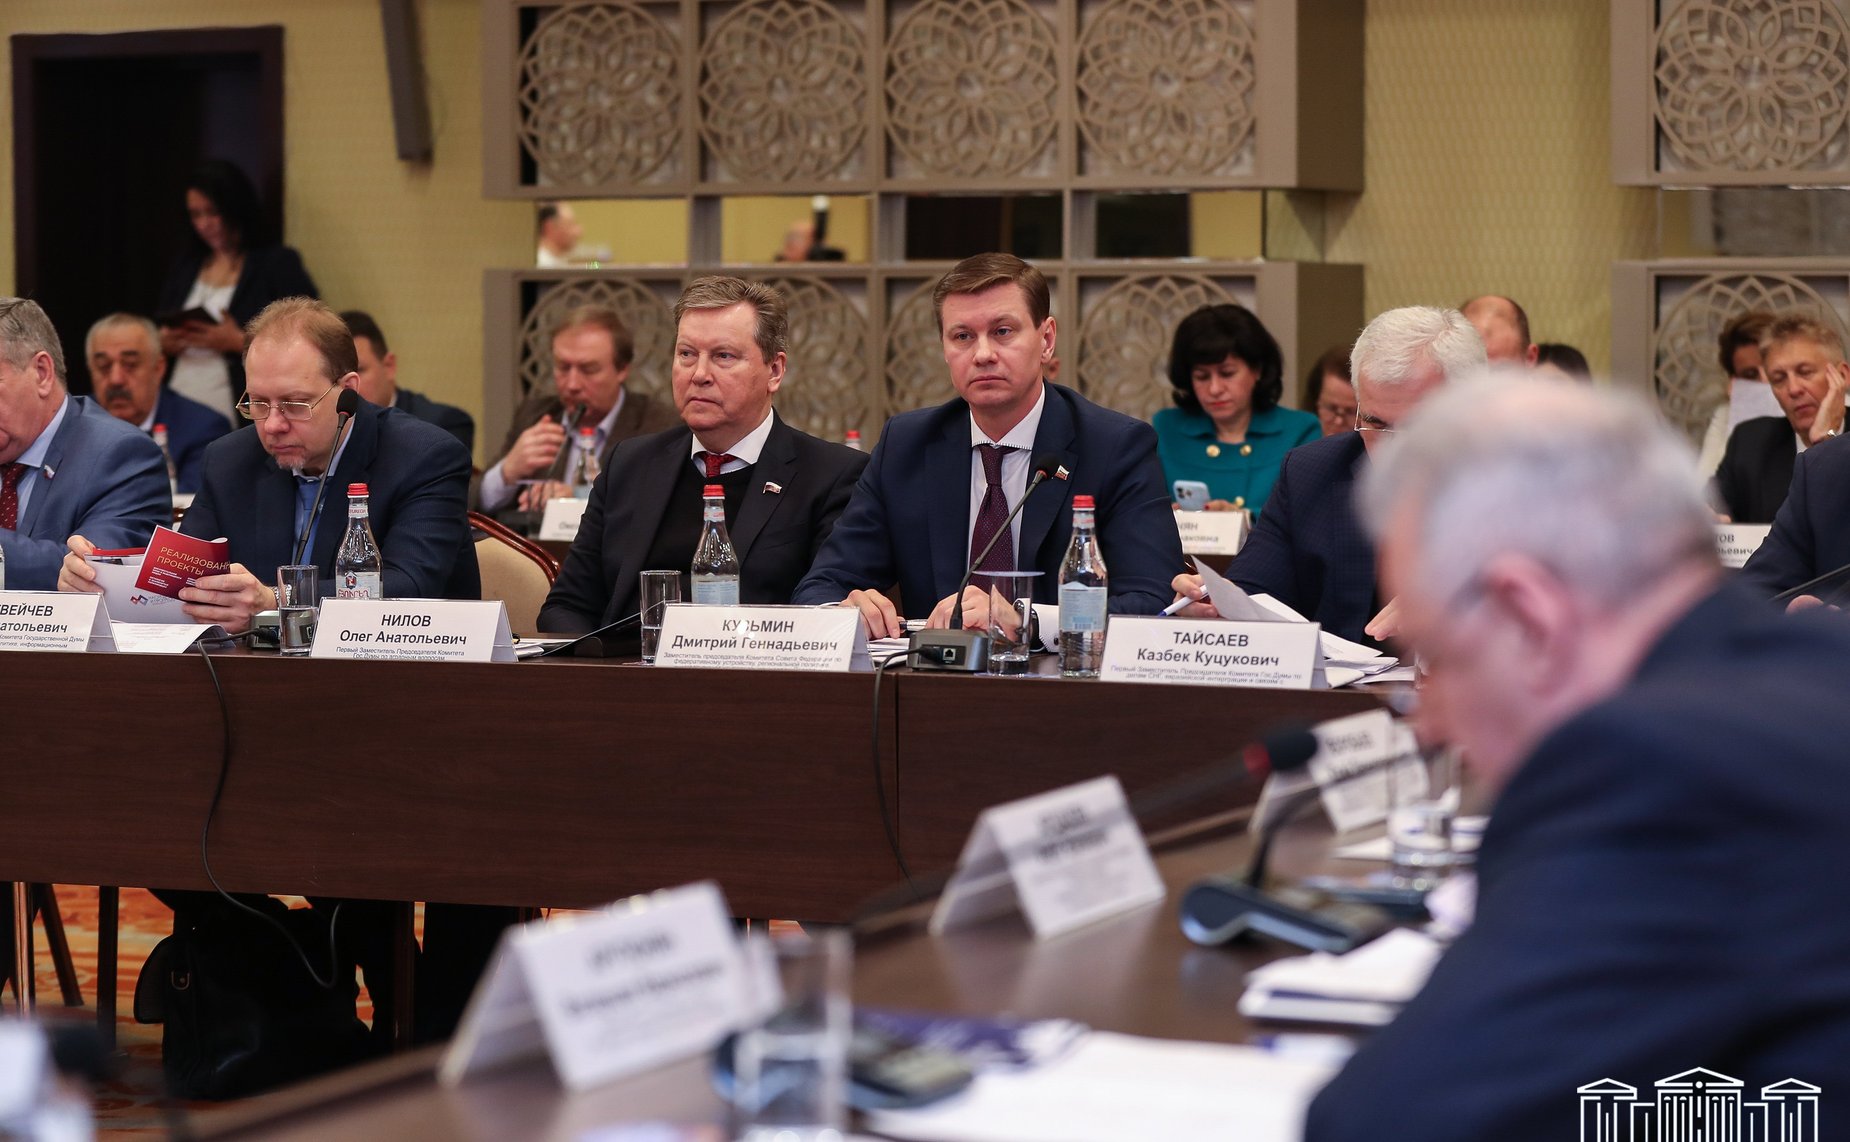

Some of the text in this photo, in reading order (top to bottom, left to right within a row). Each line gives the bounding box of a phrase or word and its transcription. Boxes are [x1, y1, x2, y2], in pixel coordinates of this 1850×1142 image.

[156, 555, 205, 577] ПРОЕКТЫ
[0, 603, 54, 617] ВЕЙЧЕВ
[0, 622, 68, 633] атольевич
[381, 614, 431, 627] НИЛОВ
[339, 629, 467, 645] Олег Анатольевич
[672, 635, 838, 651] Дмитрий Геннадьевич
[1173, 630, 1249, 647] ТАЙСАЕВ
[336, 646, 358, 654] Первый
[359, 647, 395, 655] Заместитель
[397, 648, 437, 656] Председателя
[703, 653, 745, 661] председателя
[1137, 648, 1280, 667] Казбек Куцукович
[1138, 666, 1179, 674] Заместитель
